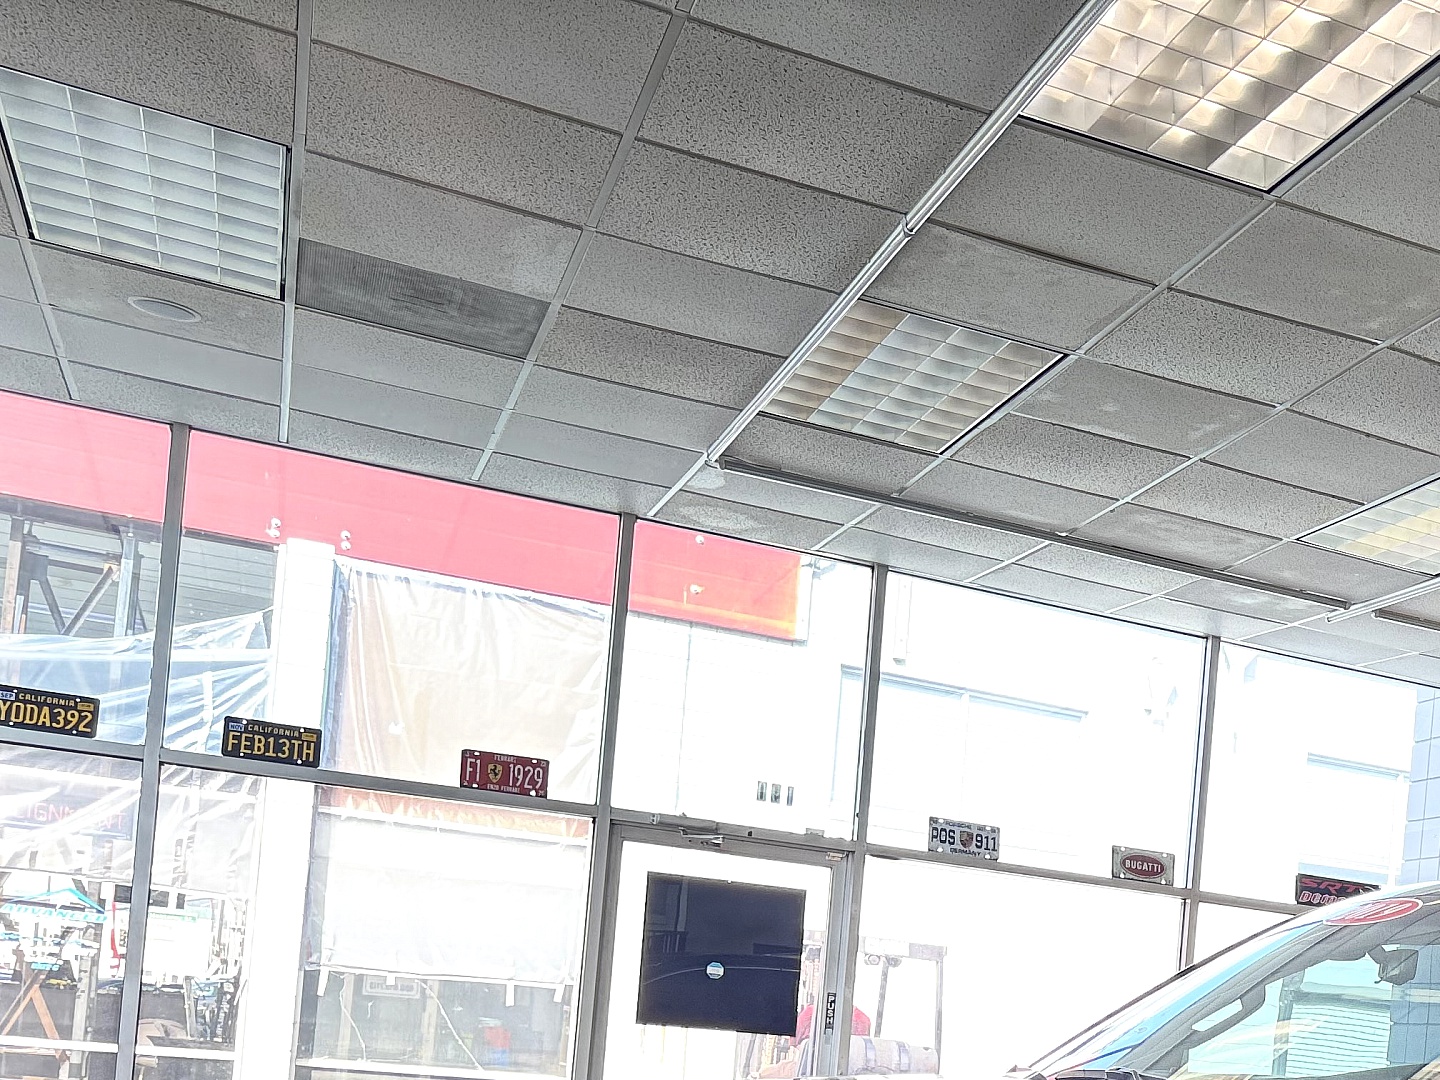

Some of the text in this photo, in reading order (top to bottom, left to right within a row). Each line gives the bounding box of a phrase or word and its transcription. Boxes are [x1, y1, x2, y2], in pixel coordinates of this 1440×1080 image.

[18, 693, 75, 707] CALIFORNIA
[0, 700, 93, 733] YODA392
[248, 724, 299, 737] CALIFORNIA
[227, 732, 315, 762] FEB13TH
[466, 758, 543, 789] F1 1929
[931, 826, 956, 846] POS
[975, 833, 998, 852] 911
[1125, 859, 1161, 873] BUGATTI
[1299, 877, 1364, 895] SRT
[826, 995, 835, 1025] PUSH
